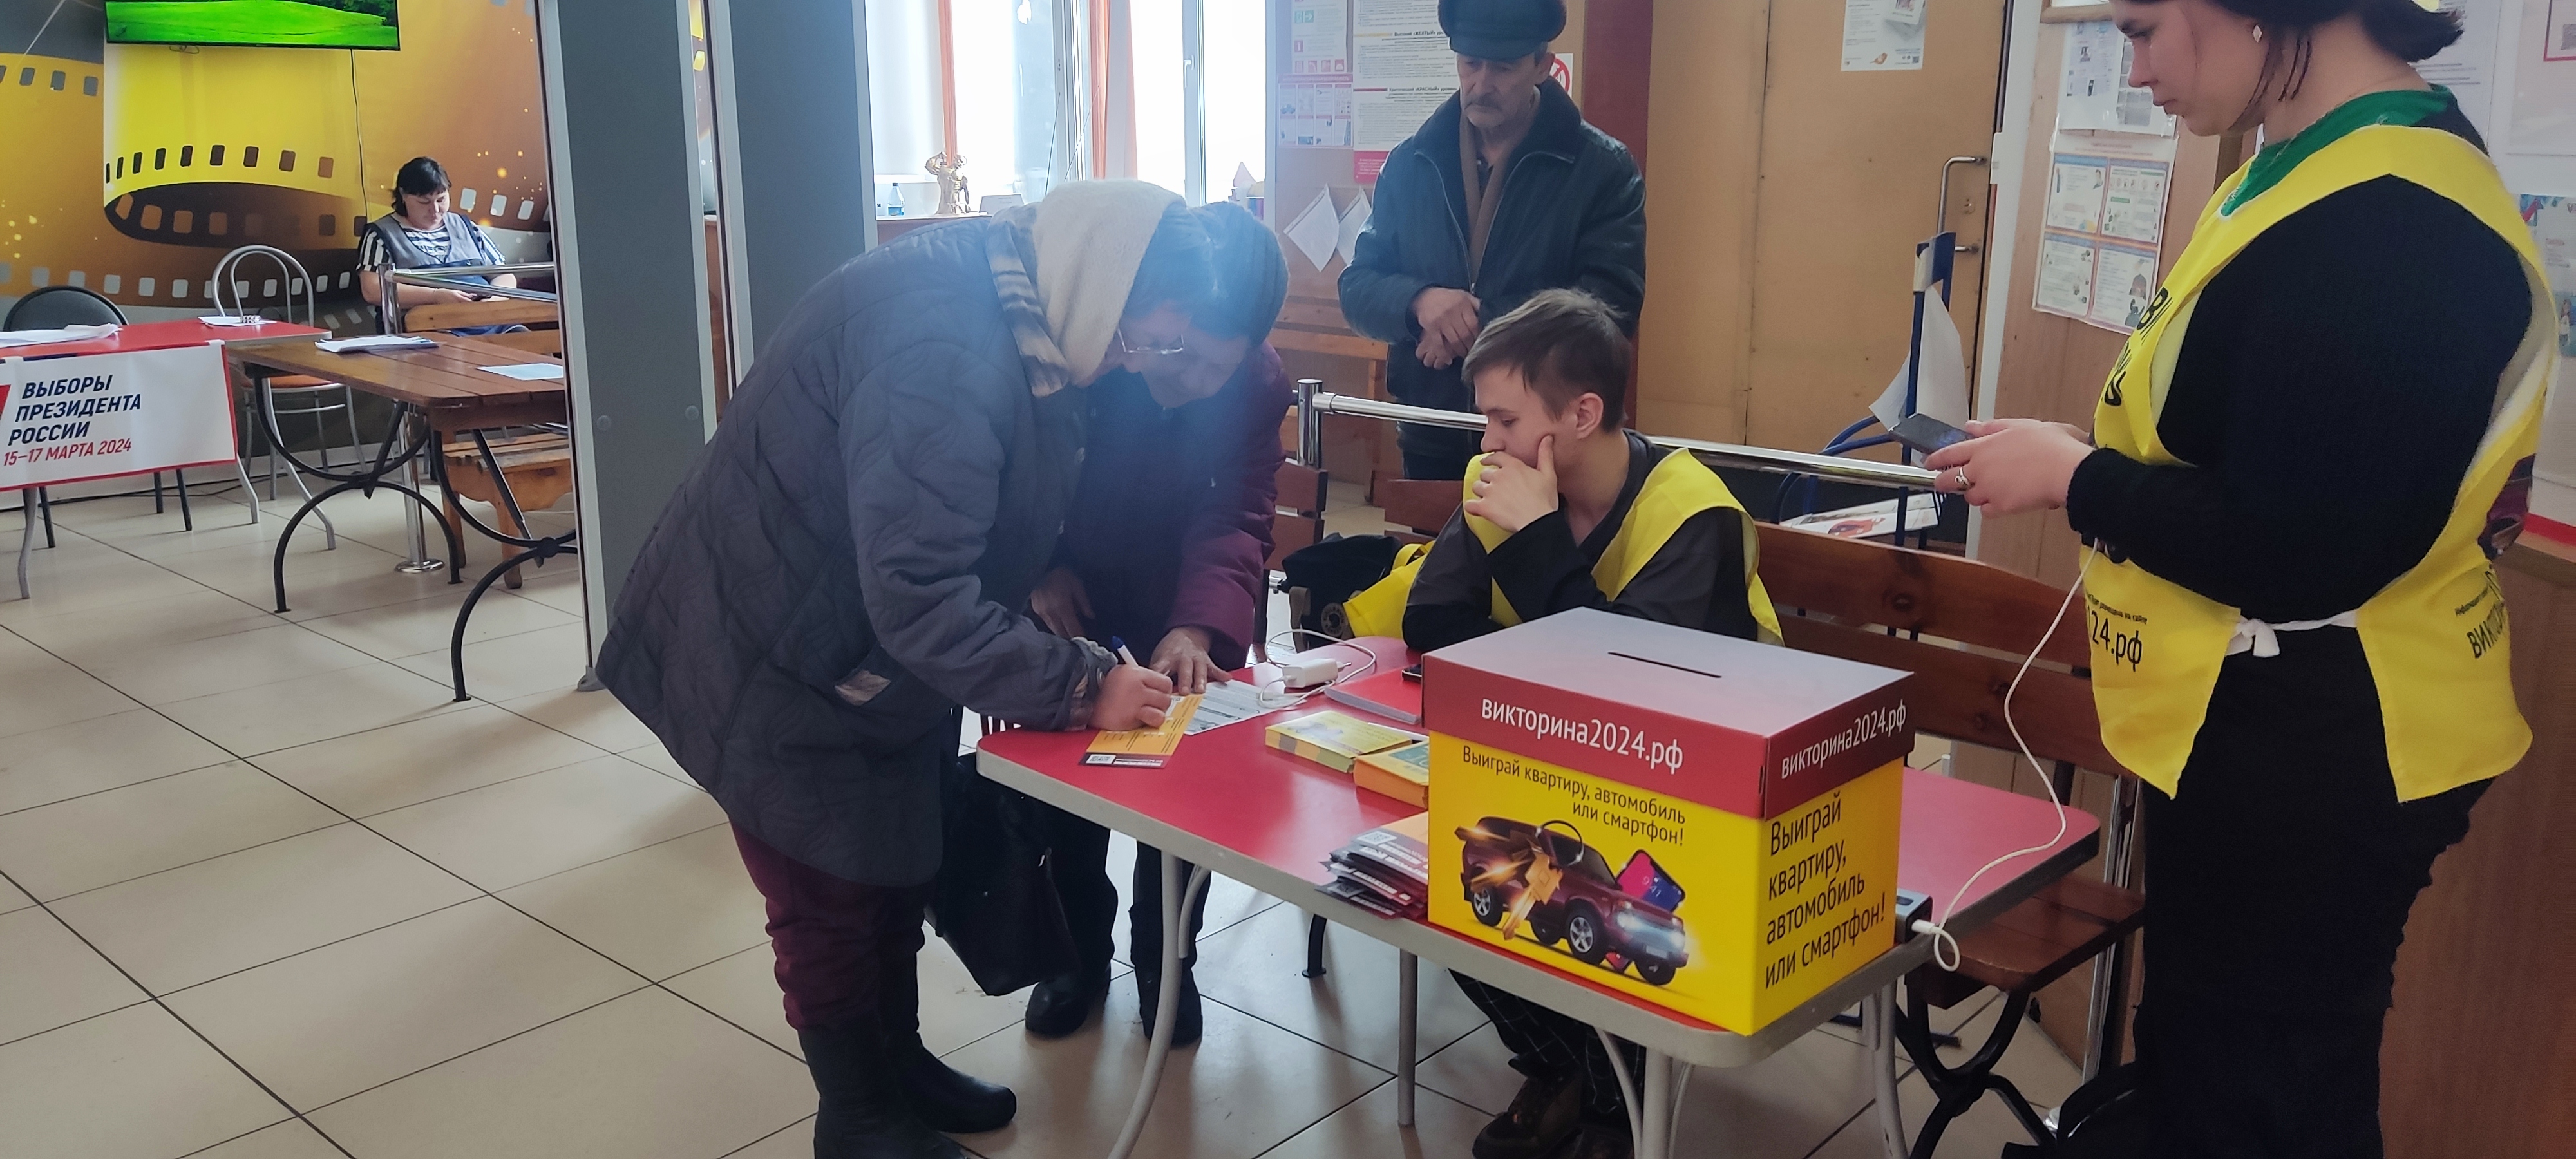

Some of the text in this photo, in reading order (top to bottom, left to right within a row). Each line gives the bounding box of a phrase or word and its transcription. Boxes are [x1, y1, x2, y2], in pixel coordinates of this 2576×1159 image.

[15, 394, 140, 422] ПРЕЗИДЕНТА
[22, 375, 113, 399] ВЫБОРЫ
[8, 421, 90, 446] РОССИИ
[45, 442, 94, 461] МАРТА
[97, 438, 131, 455] 2024
[2088, 608, 2142, 672] 24.рф
[1482, 699, 1683, 775] викторина2024.рф
[1781, 699, 1906, 779] викторина2024.рф
[1463, 745, 1520, 777] Выиграй
[1524, 767, 1590, 800] квартиру,
[1595, 787, 1685, 824] автомобиль
[1573, 802, 1684, 846] или смартфон!
[1770, 791, 1841, 856] Выиграй
[1768, 840, 1846, 901] квартиру,
[1765, 892, 1886, 989] или смартфон!
[1766, 872, 1865, 945] автомобиль
